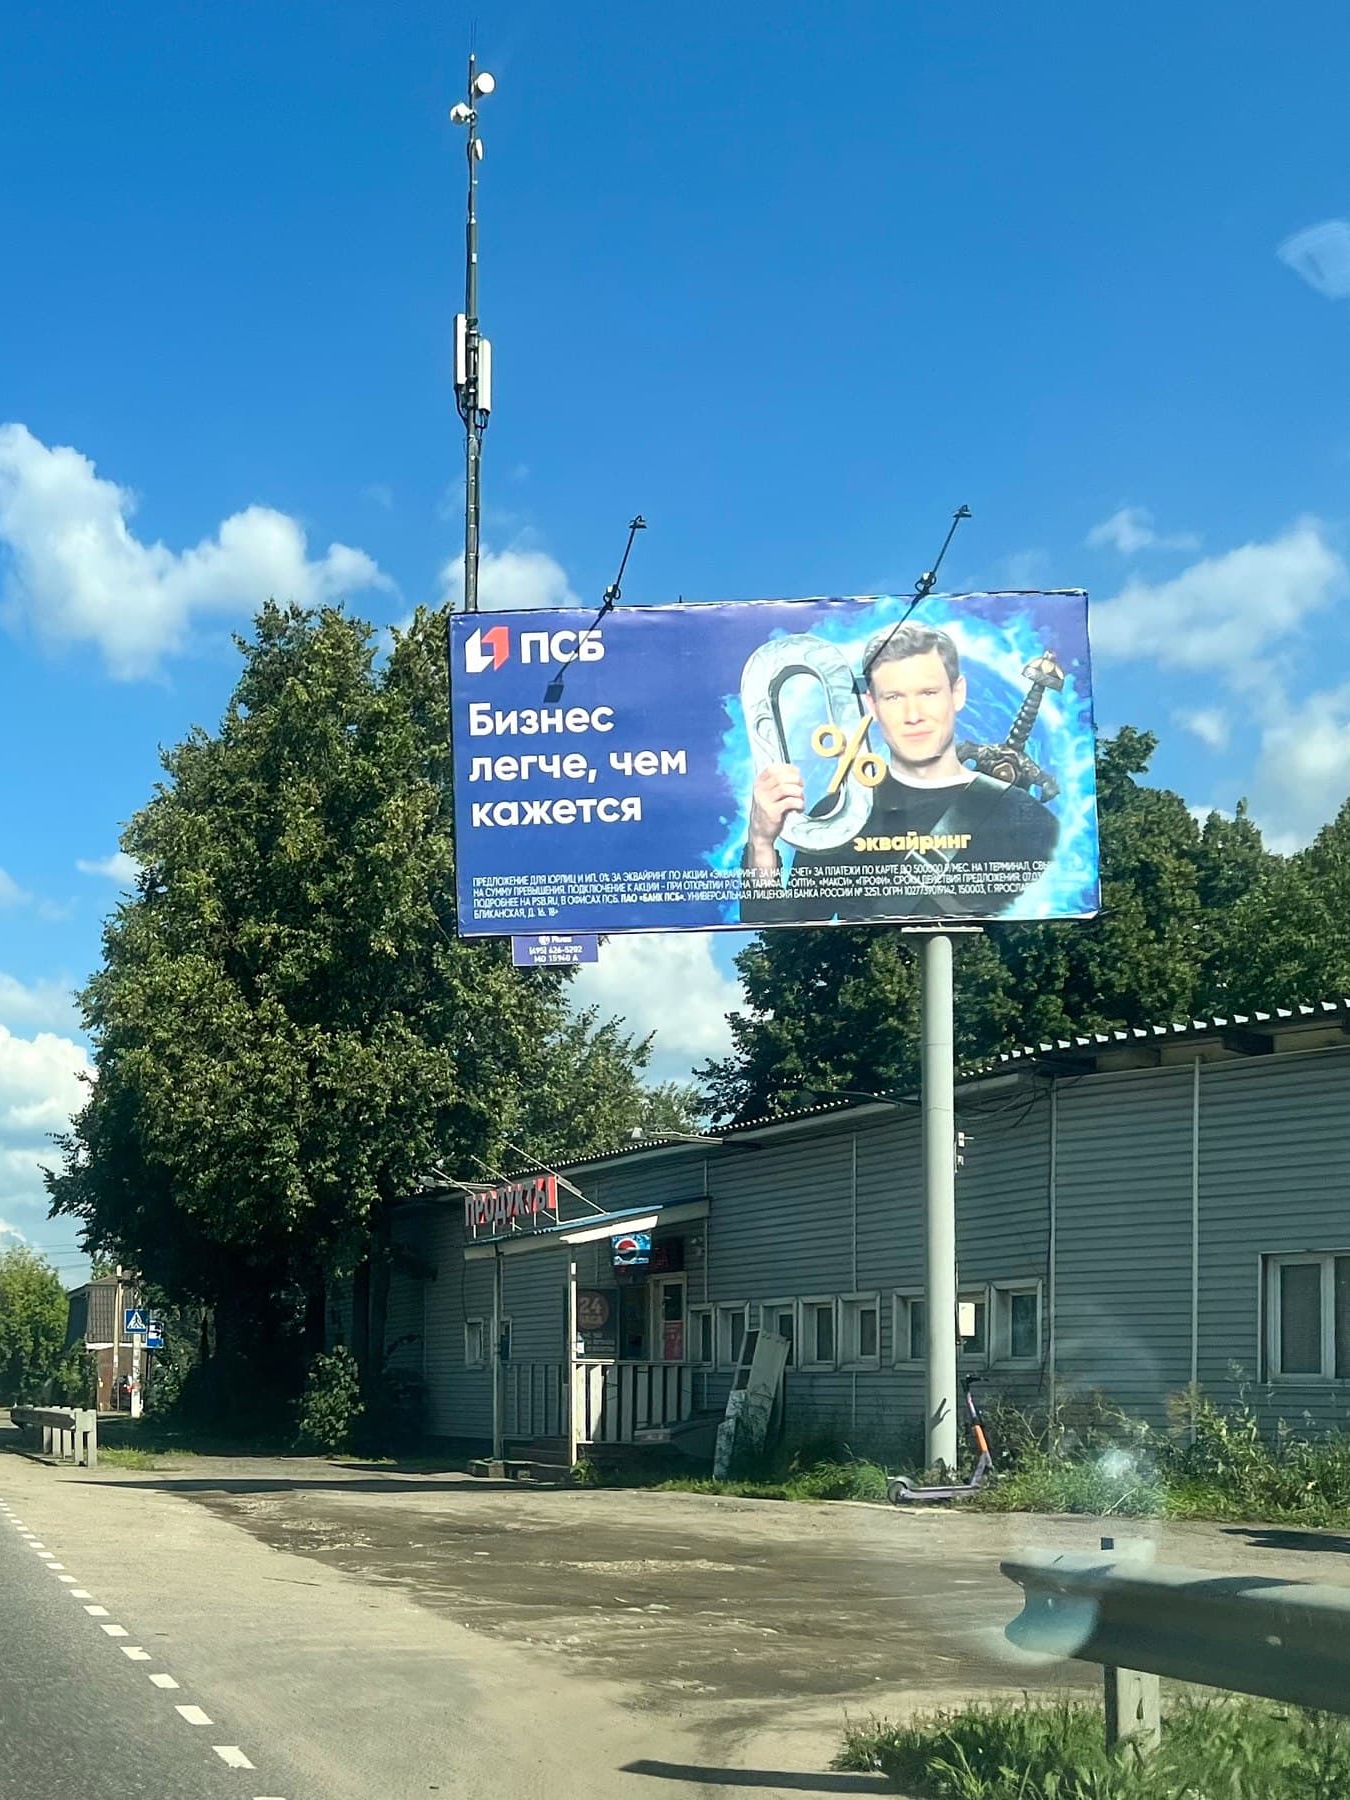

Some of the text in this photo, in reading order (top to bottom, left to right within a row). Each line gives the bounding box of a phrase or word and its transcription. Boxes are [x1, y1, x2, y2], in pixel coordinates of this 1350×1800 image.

[520, 630, 605, 664] ПСБ
[468, 702, 615, 736] Бизнес
[468, 750, 687, 783] легче, чем
[471, 795, 642, 828] кажется
[853, 831, 972, 854] эквайринг
[473, 876, 529, 887] ПРЕДЛОЖЕНИЕ
[530, 875, 546, 885] ДЛЯ
[547, 874, 576, 885] ЮРЛИЦ
[577, 874, 584, 883] И
[599, 873, 610, 882] 0%
[611, 872, 622, 882] ЗА
[623, 870, 667, 882] ЭКВАЙРИНГ
[668, 871, 681, 880] ПО
[682, 870, 708, 880] АКЦИИ
[759, 868, 769, 877] ЗА
[814, 867, 824, 876] ЗА
[825, 866, 861, 875] ПЛАТЕЖИ
[862, 865, 874, 874] ПО
[875, 864, 899, 874] КАРТЕ
[900, 864, 912, 874] ДО
[971, 863, 983, 872] НА
[473, 888, 484, 897] НА
[485, 887, 513, 897] СУММУ
[567, 883, 626, 894] ПОДКЛЮЧЕНИЕ
[627, 883, 633, 892] К
[634, 882, 660, 892] АКЦИИ
[666, 881, 682, 890] ПРИ
[683, 880, 723, 890] ОТКРЫТИИ
[741, 879, 751, 889] НА
[473, 898, 519, 908] ПОДРОБНЕЕ
[520, 897, 531, 906] НА
[561, 896, 566, 905] В
[567, 895, 601, 905] ОФИСАХ
[602, 894, 619, 904] ПСБ.
[621, 893, 637, 903] ПАО
[639, 892, 663, 903] «БАНК
[687, 889, 751, 901] УНИВЕРСАЛЬНАЯ
[753, 889, 792, 900] ЛИЦЕНЗИЯ
[794, 888, 818, 898] БАНКА
[820, 887, 853, 898] РОССИИ
[882, 886, 904, 896] ОГРН
[464, 1175, 556, 1227] ПРОДУКТЫ
[579, 1296, 602, 1314] 24
